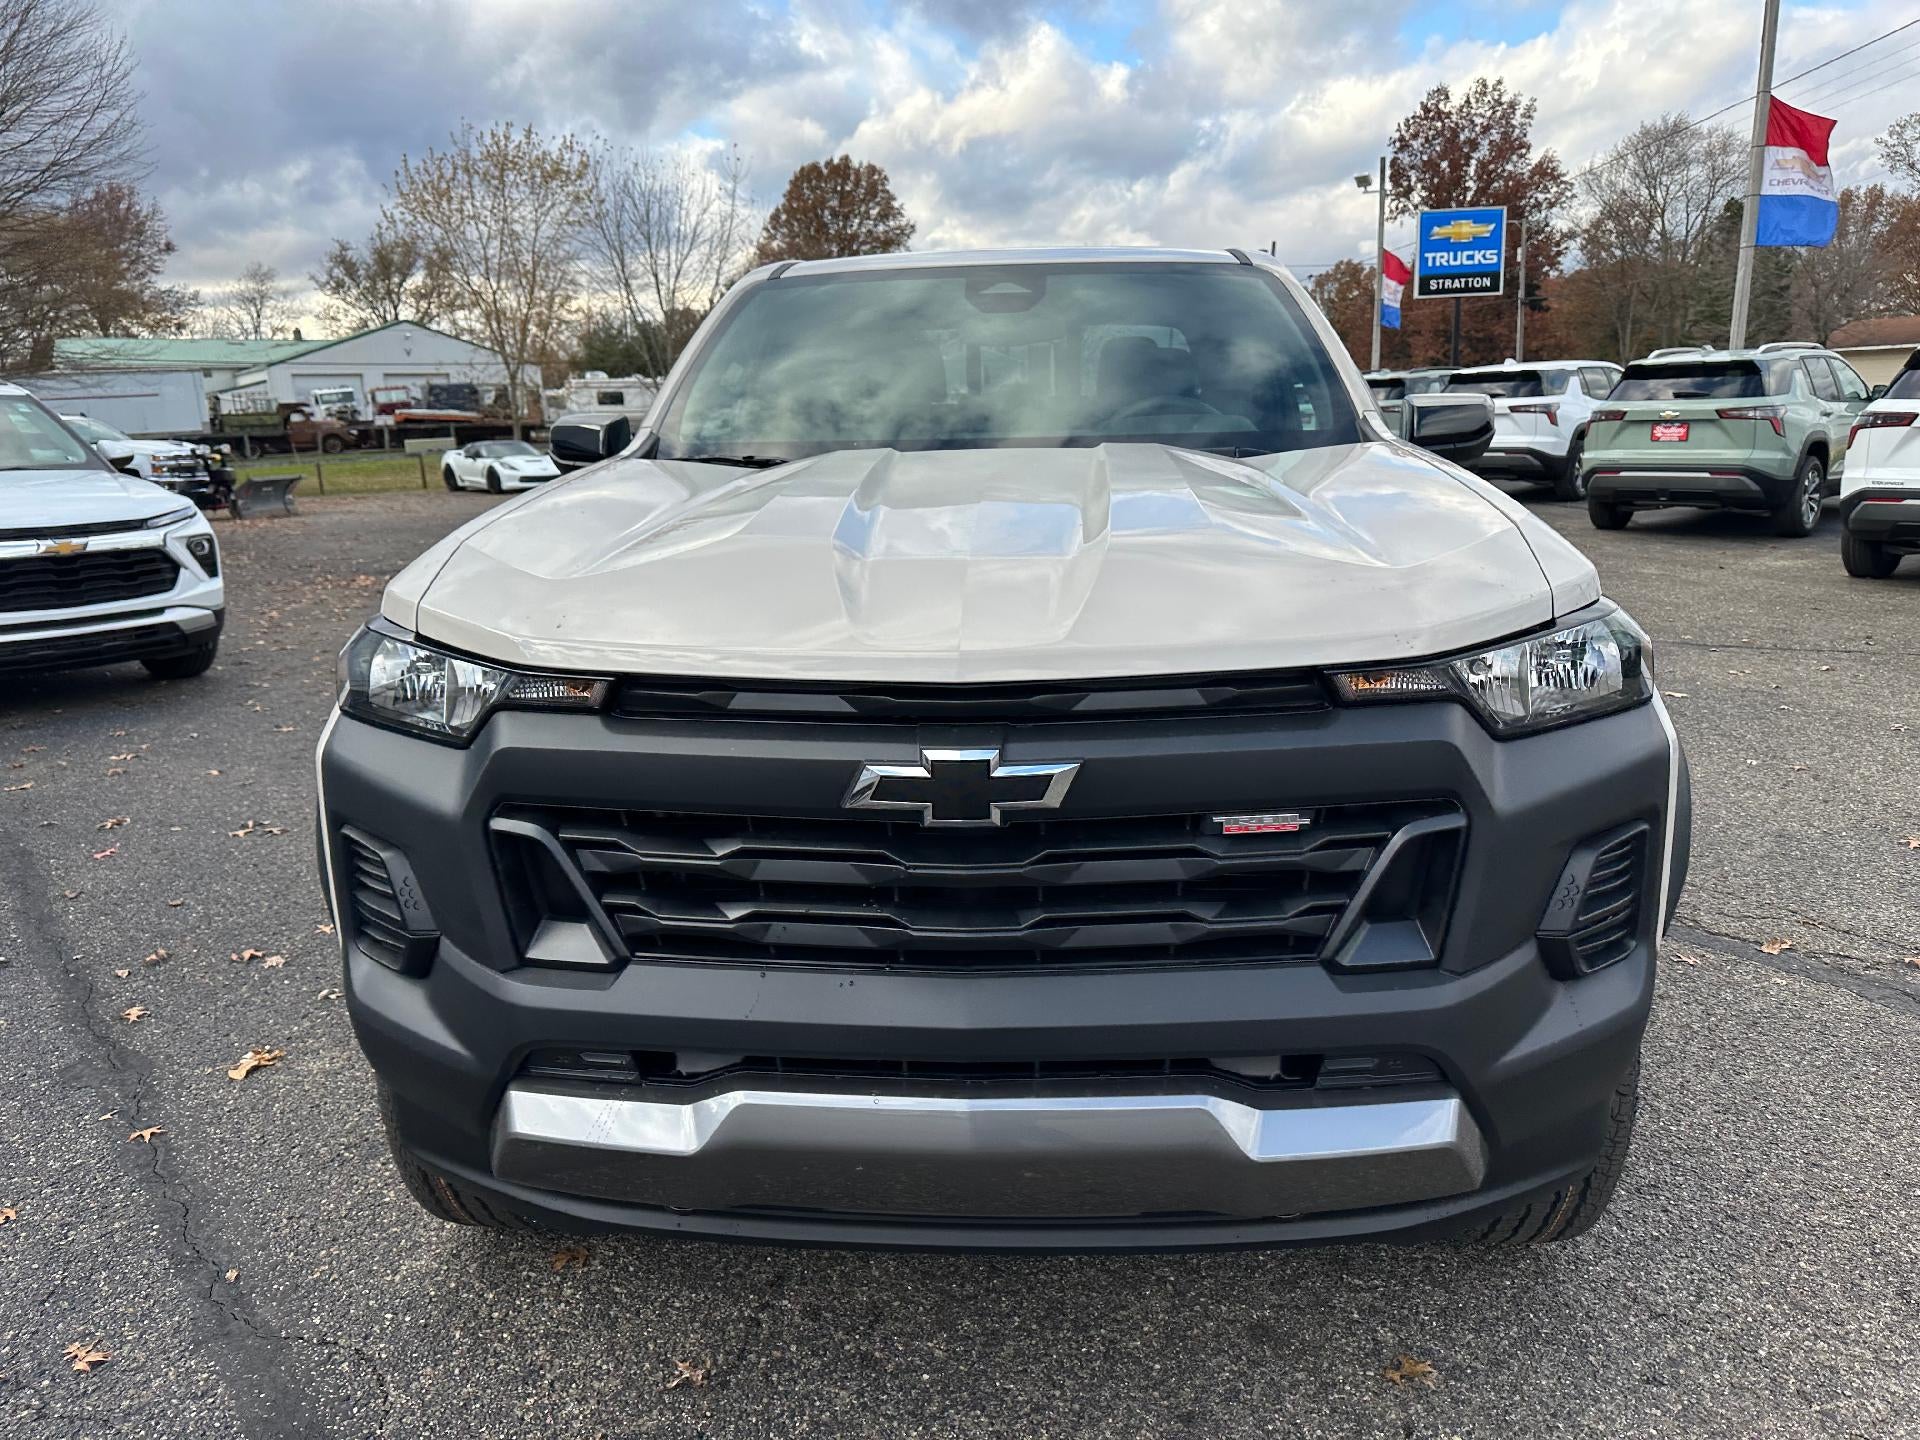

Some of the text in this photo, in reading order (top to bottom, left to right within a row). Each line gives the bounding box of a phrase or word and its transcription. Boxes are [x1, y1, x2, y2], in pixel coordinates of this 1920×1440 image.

[1768, 177, 1830, 196] CHEVRT
[1424, 249, 1499, 267] TRUCKS
[1429, 277, 1491, 290] STRATTON
